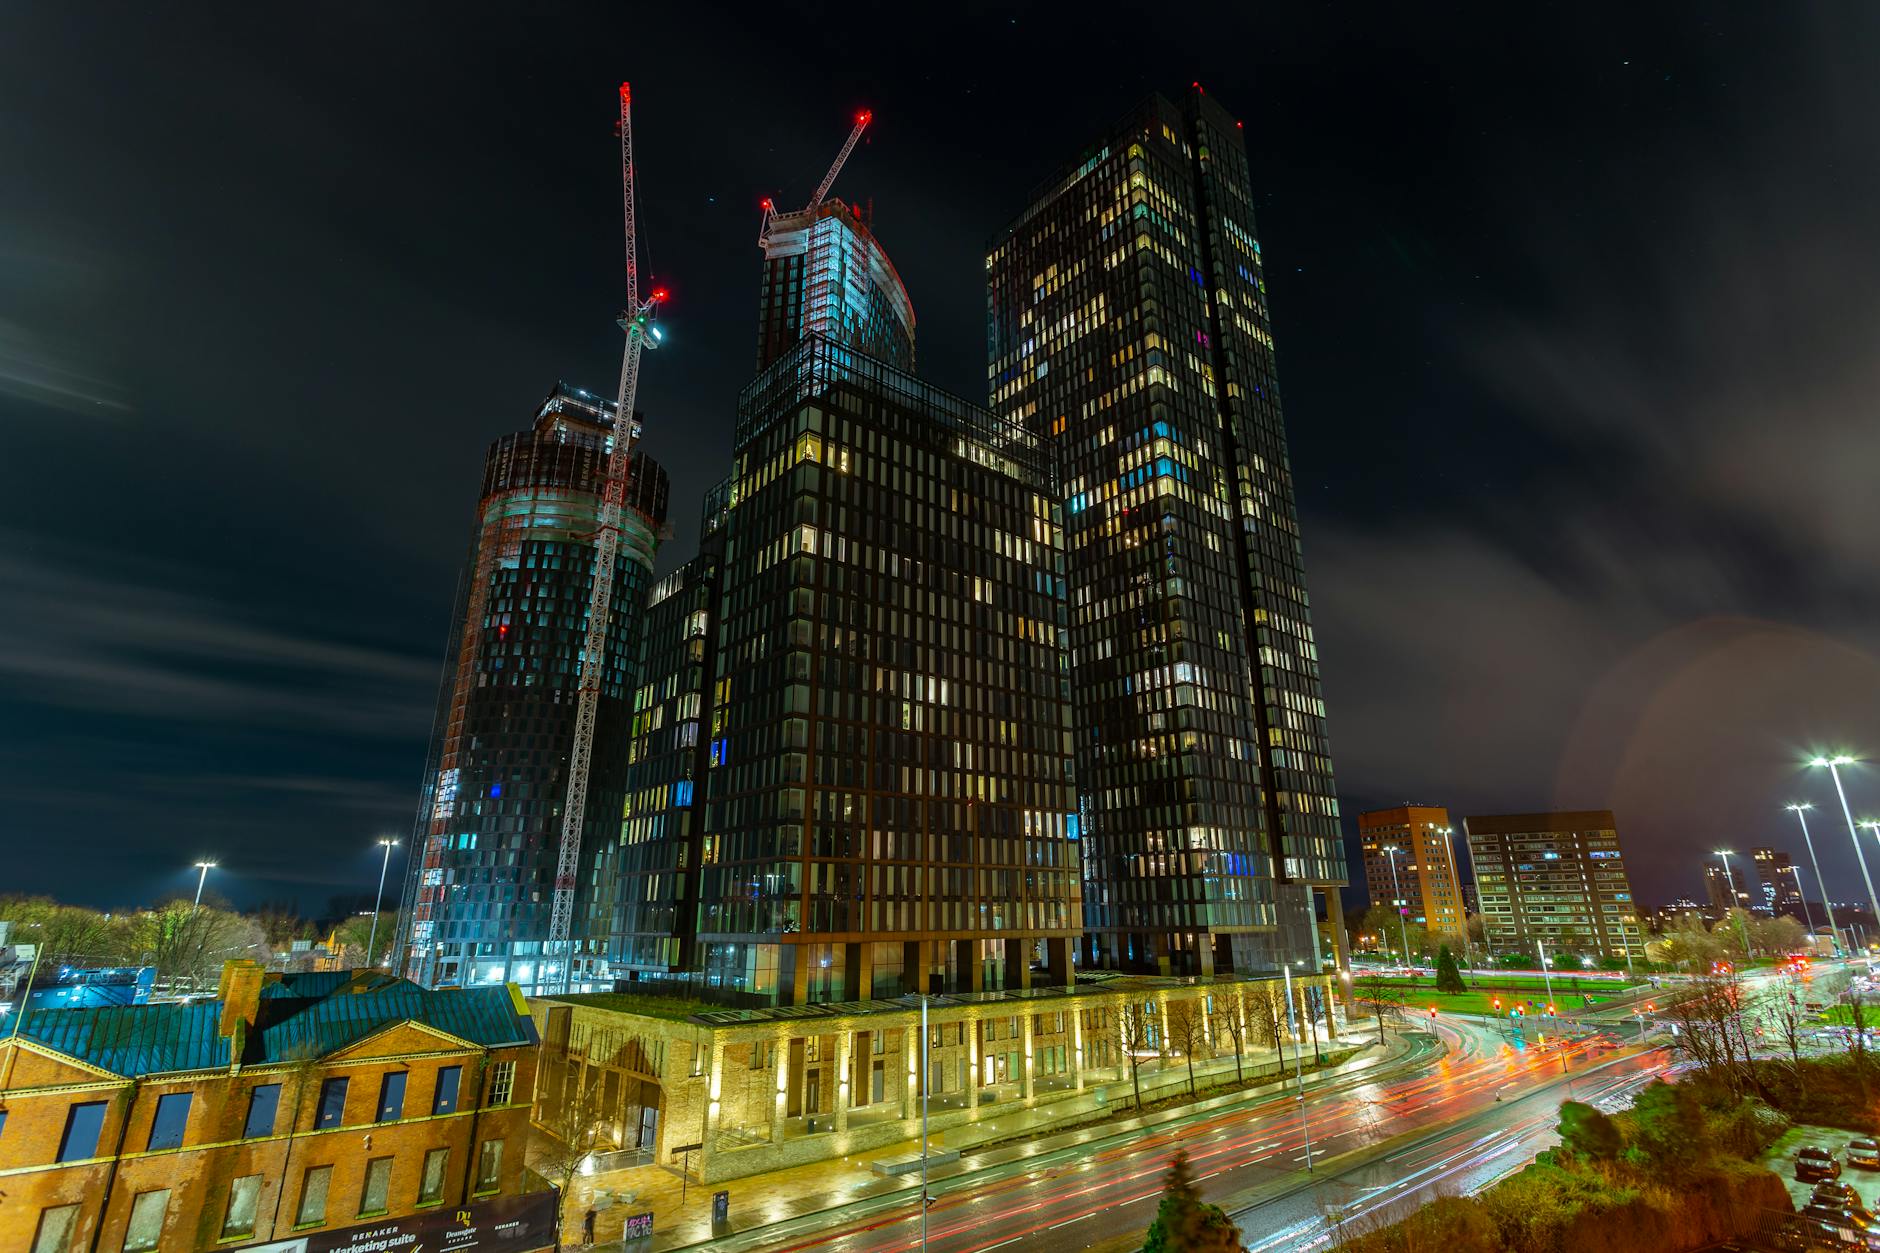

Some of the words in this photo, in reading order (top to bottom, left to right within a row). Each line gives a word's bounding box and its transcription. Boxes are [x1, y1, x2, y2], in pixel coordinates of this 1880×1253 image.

[351, 1226, 399, 1242] RENAKER
[445, 1227, 477, 1239] Deansgate
[329, 1240, 388, 1253] Marketing
[387, 1233, 417, 1245] suite
